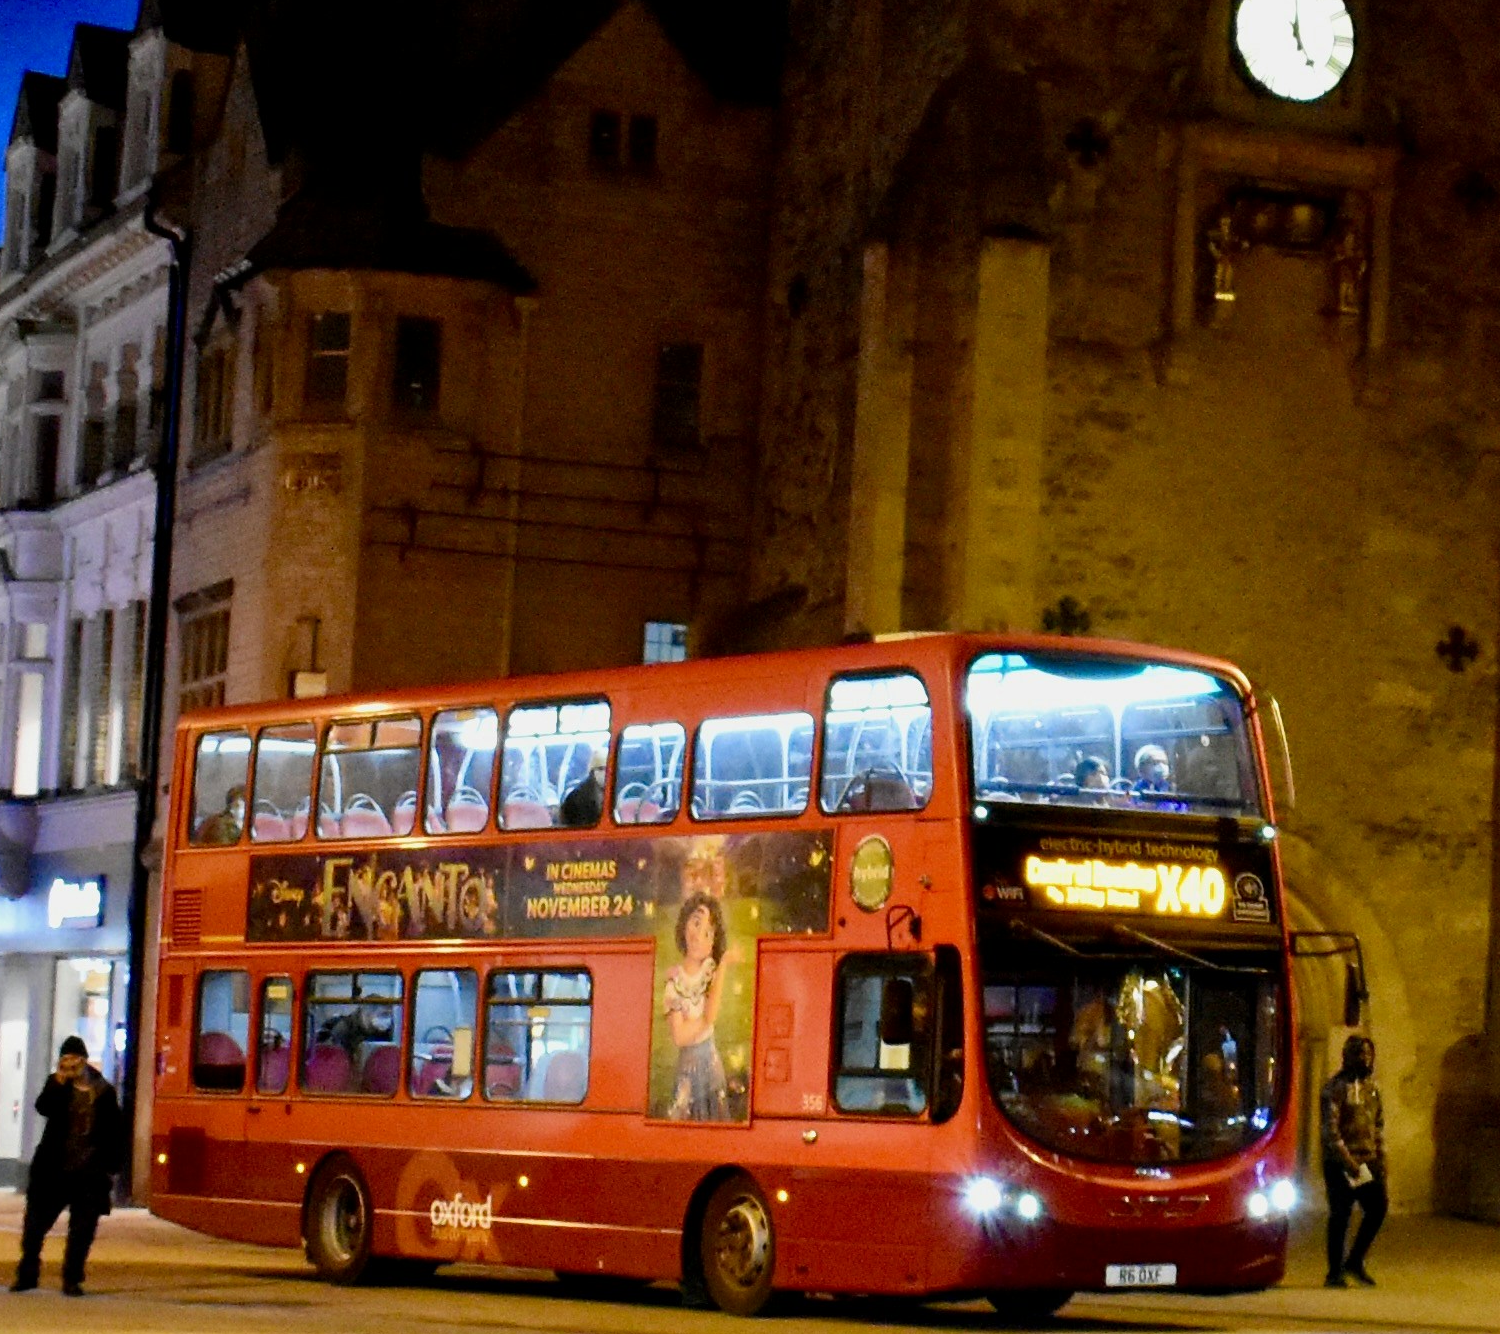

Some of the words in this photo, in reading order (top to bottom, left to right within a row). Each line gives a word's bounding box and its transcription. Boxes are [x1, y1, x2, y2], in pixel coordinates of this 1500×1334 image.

[547, 863, 560, 881] IN
[561, 860, 616, 880] CINEMAS
[1156, 864, 1225, 915] X40
[526, 896, 611, 919] NOVEMBER
[613, 895, 633, 917] 24
[430, 1192, 492, 1229] oxford
